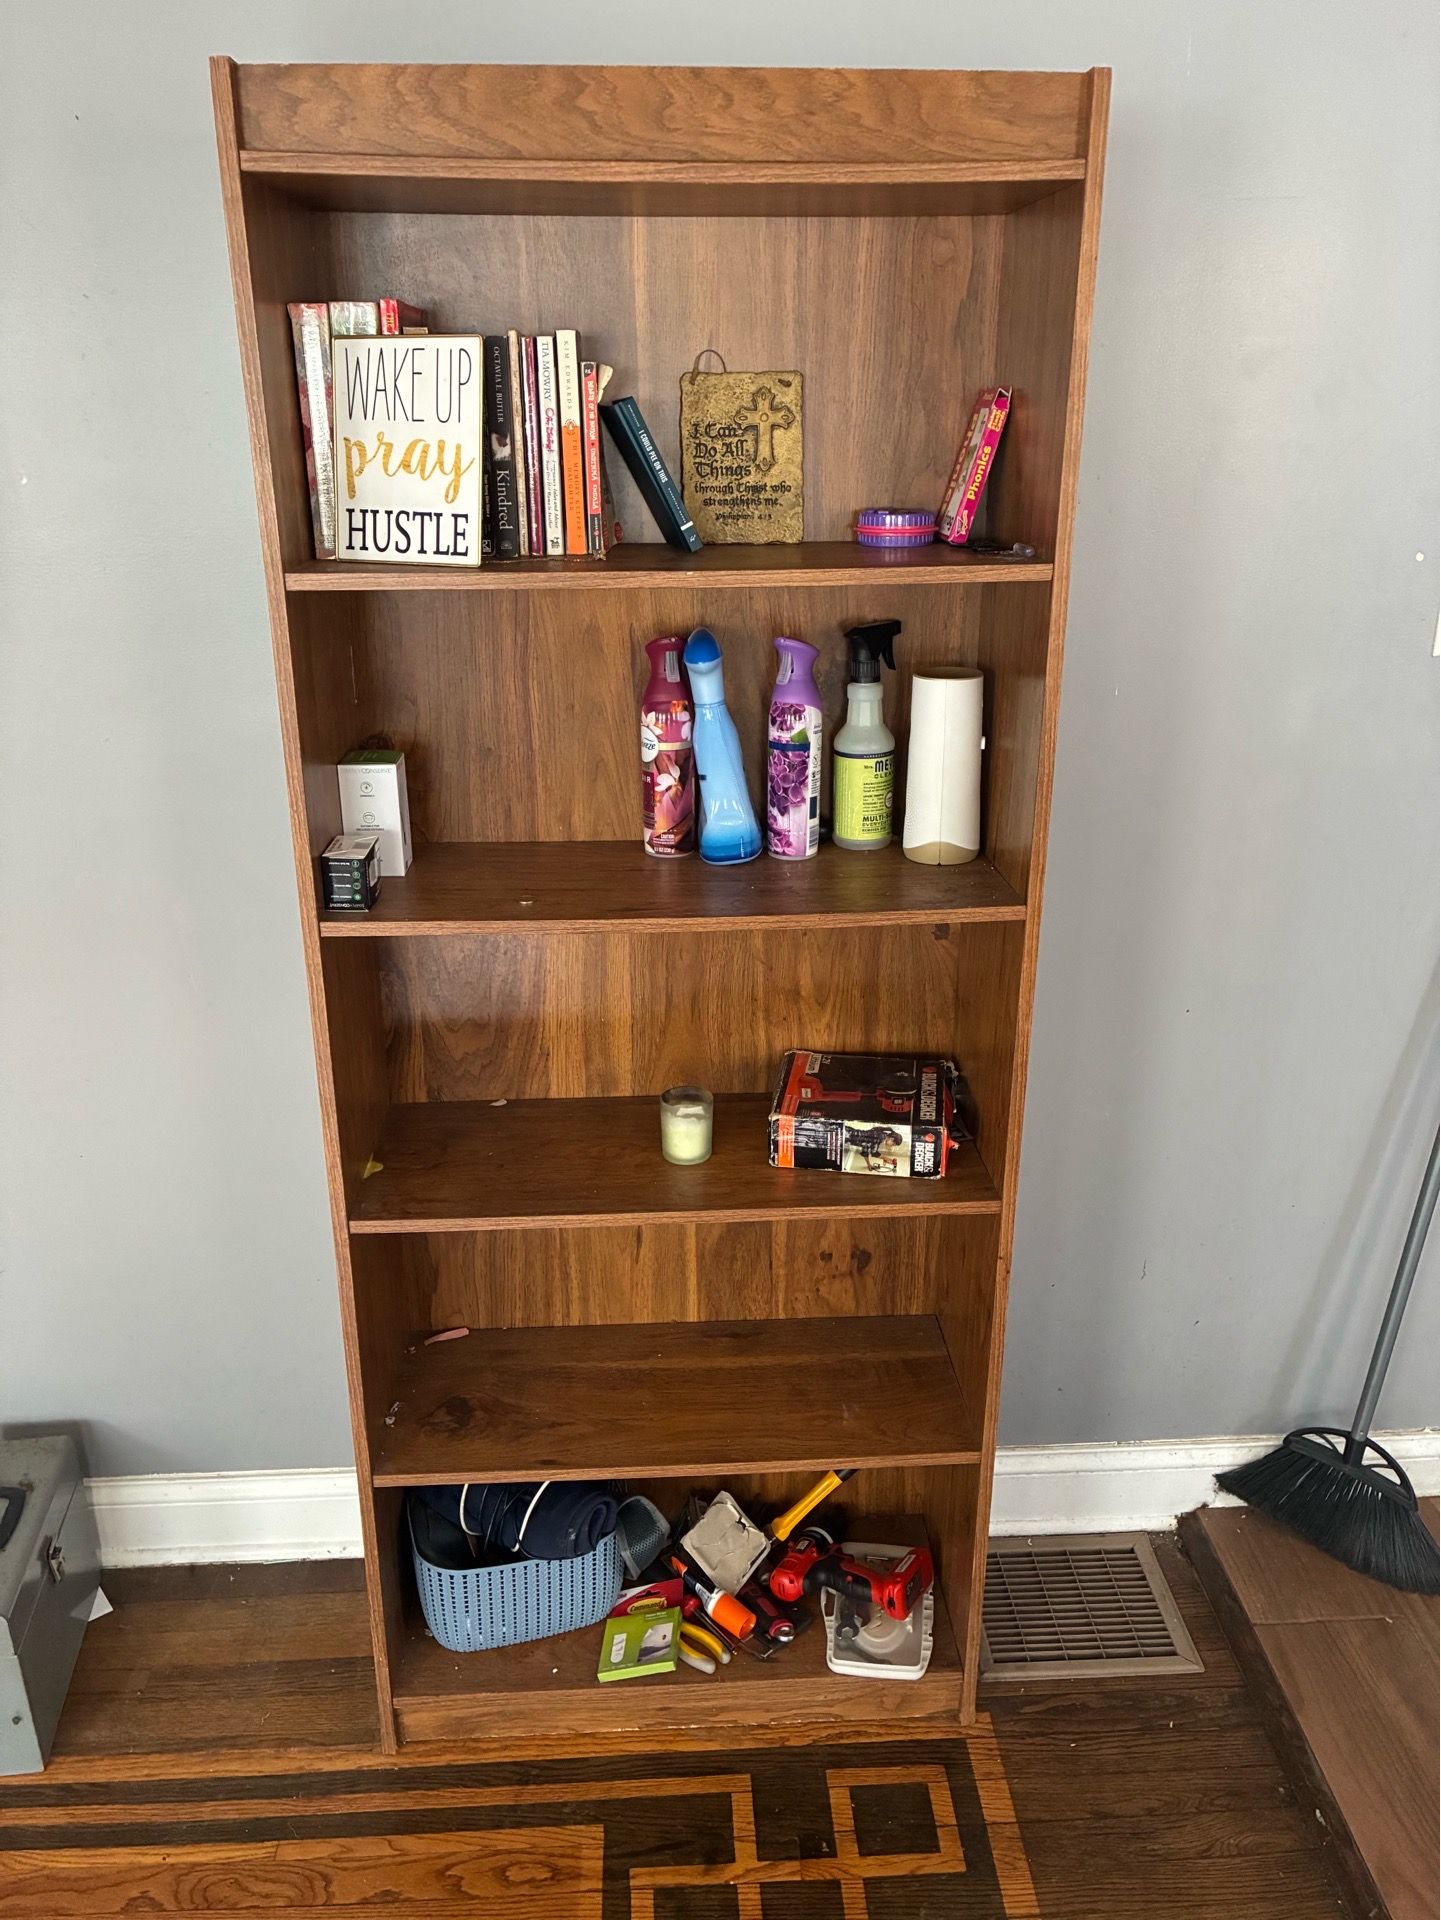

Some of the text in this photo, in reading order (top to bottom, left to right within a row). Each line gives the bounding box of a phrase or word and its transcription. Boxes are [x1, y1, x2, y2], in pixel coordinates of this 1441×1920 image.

[493, 346, 501, 383] OCTAVIA
[541, 342, 553, 402] TIA MOWRY
[344, 347, 472, 423] WAKE UP
[565, 365, 573, 410] EDWARDS
[496, 393, 504, 423] BUTLER
[640, 433, 653, 452] COULD
[690, 421, 738, 439] I Can
[648, 451, 658, 463] PEE
[693, 439, 748, 459] Do All
[343, 431, 476, 504] pray
[653, 461, 661, 471] ON
[656, 467, 669, 484] THIS
[693, 459, 752, 481] Things
[966, 445, 993, 500] Phonics
[496, 469, 514, 530] Kindred
[694, 480, 792, 495] through Christ who
[703, 496, 762, 508] strengthens
[345, 508, 469, 557] HUSTLE
[913, 1141, 925, 1172] DECKER
[630, 1599, 664, 1613] Command
